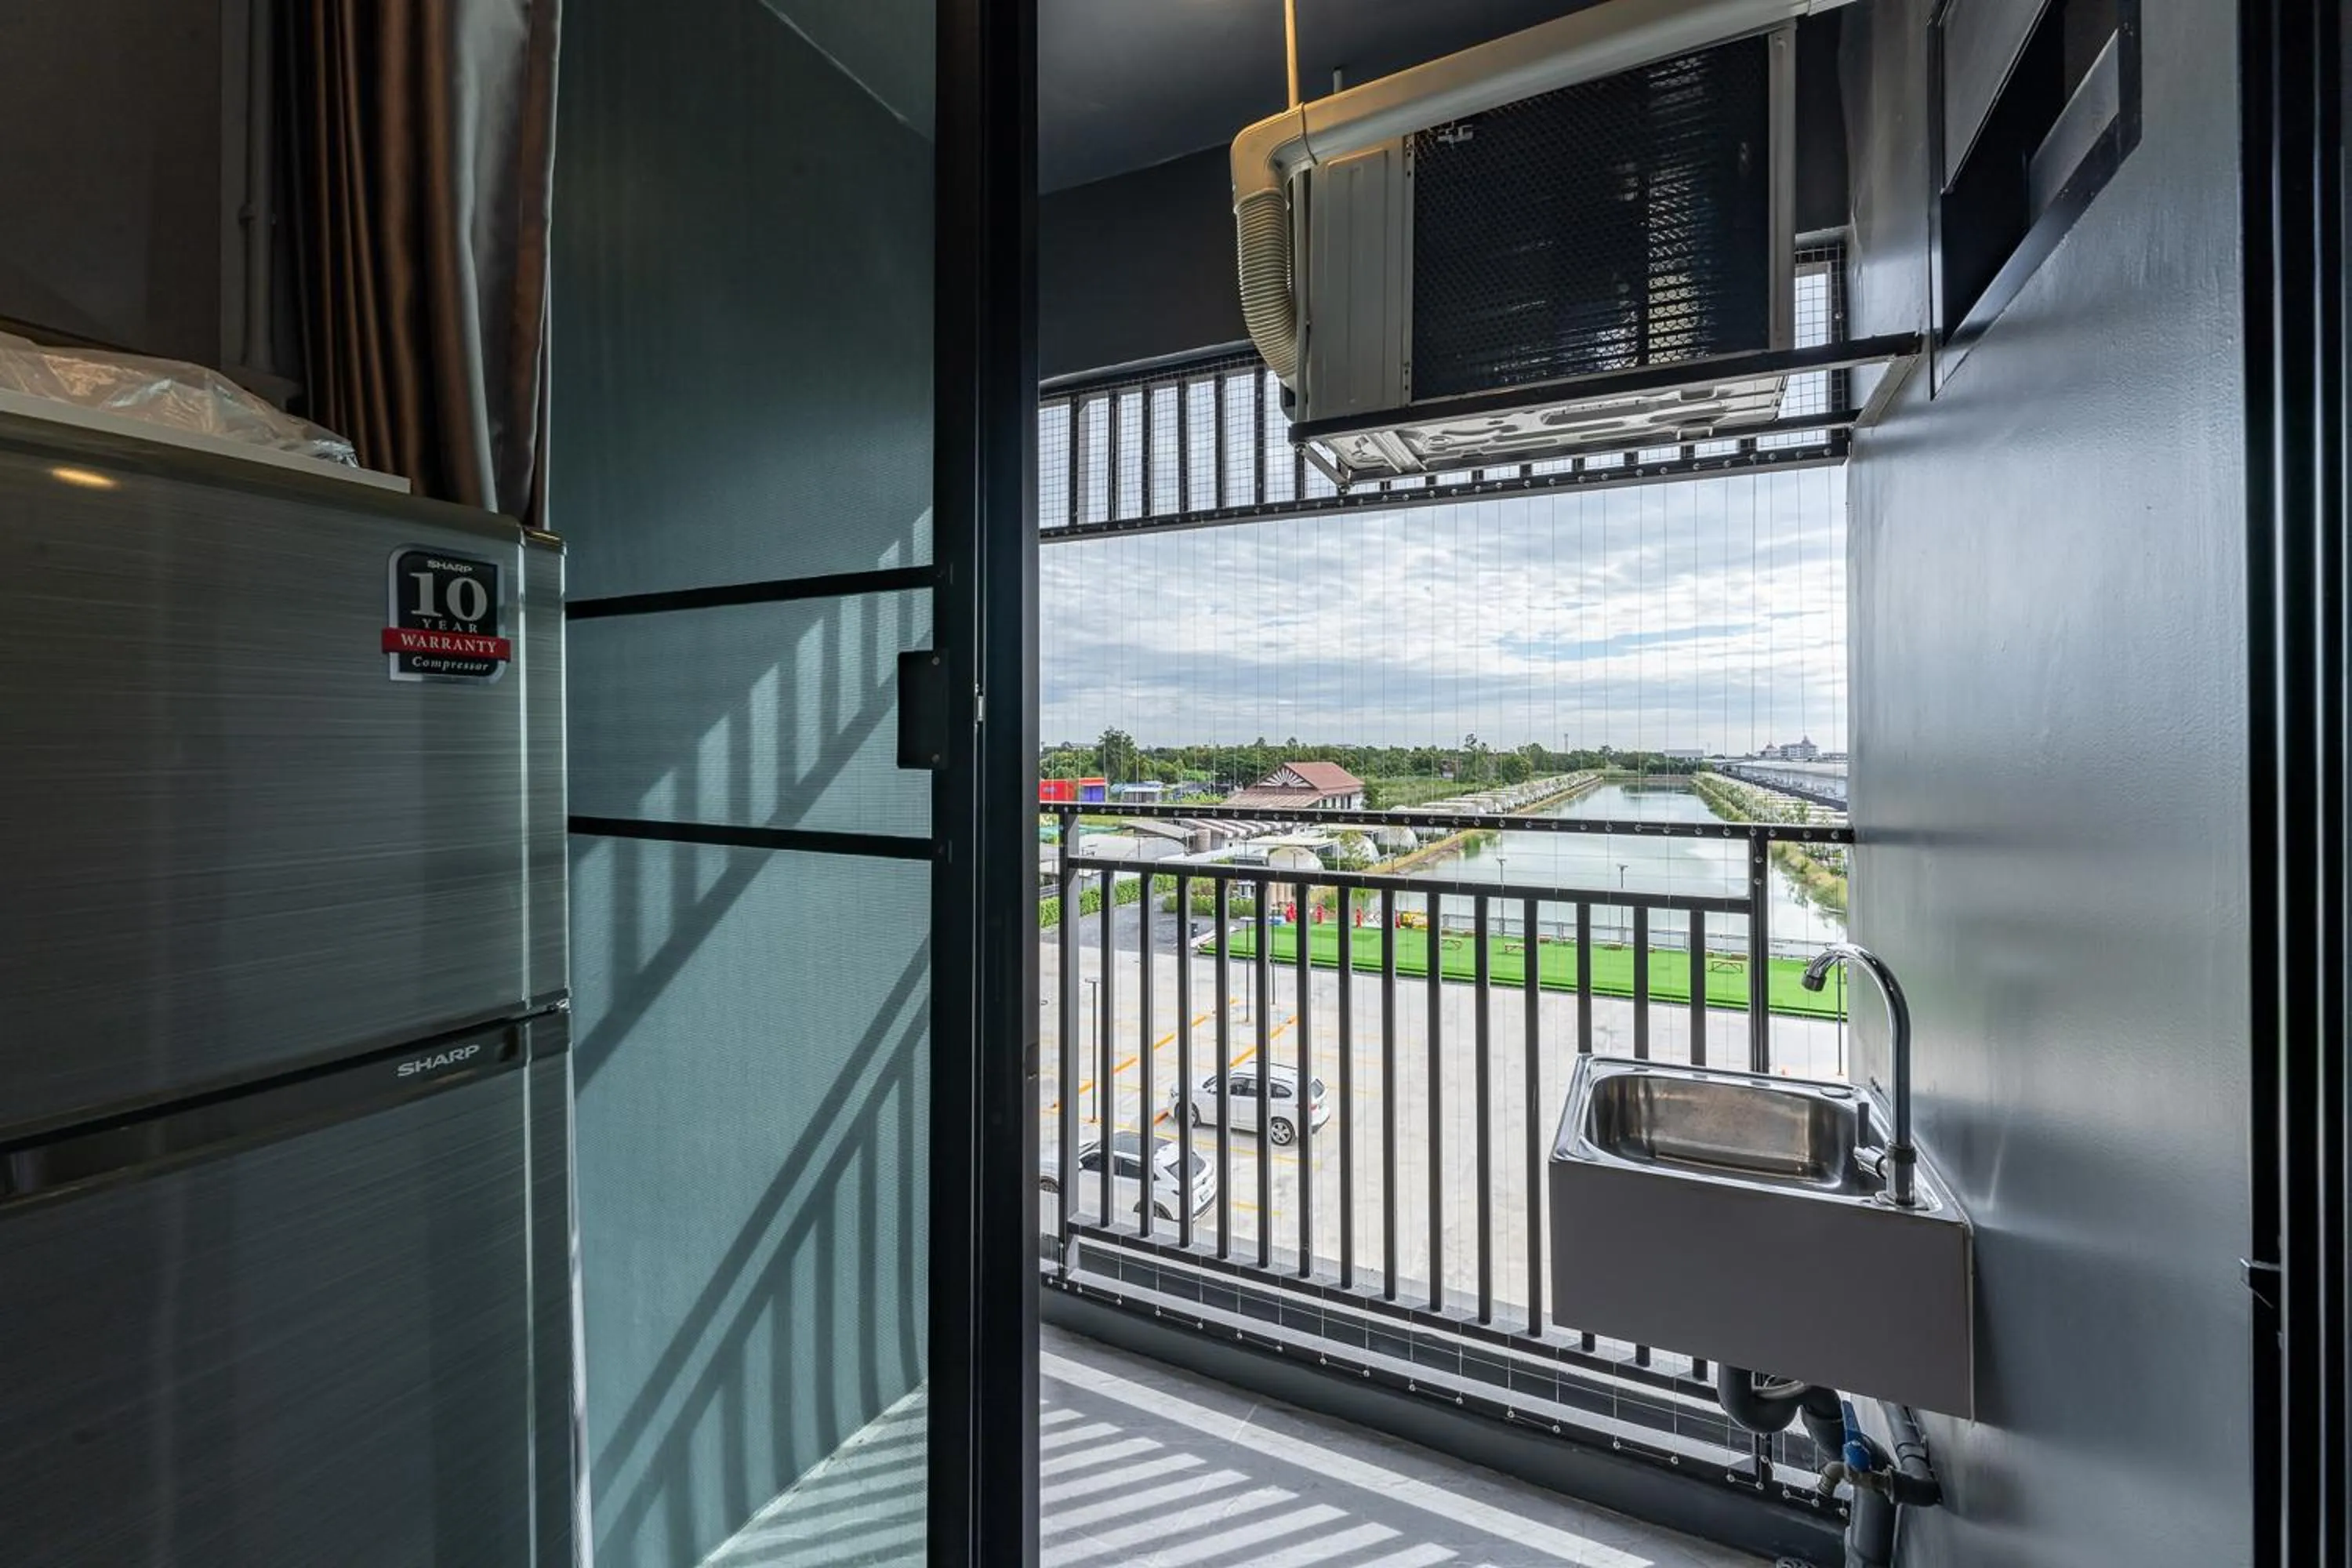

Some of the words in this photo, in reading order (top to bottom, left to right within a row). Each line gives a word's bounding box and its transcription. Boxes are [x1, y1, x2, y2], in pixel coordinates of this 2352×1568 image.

[426, 560, 473, 572] SHARP
[409, 572, 488, 622] 10
[422, 619, 478, 633] YEAR
[401, 633, 498, 653] WARRANTY
[412, 656, 489, 671] Compressor
[397, 1044, 481, 1077] SHARP
